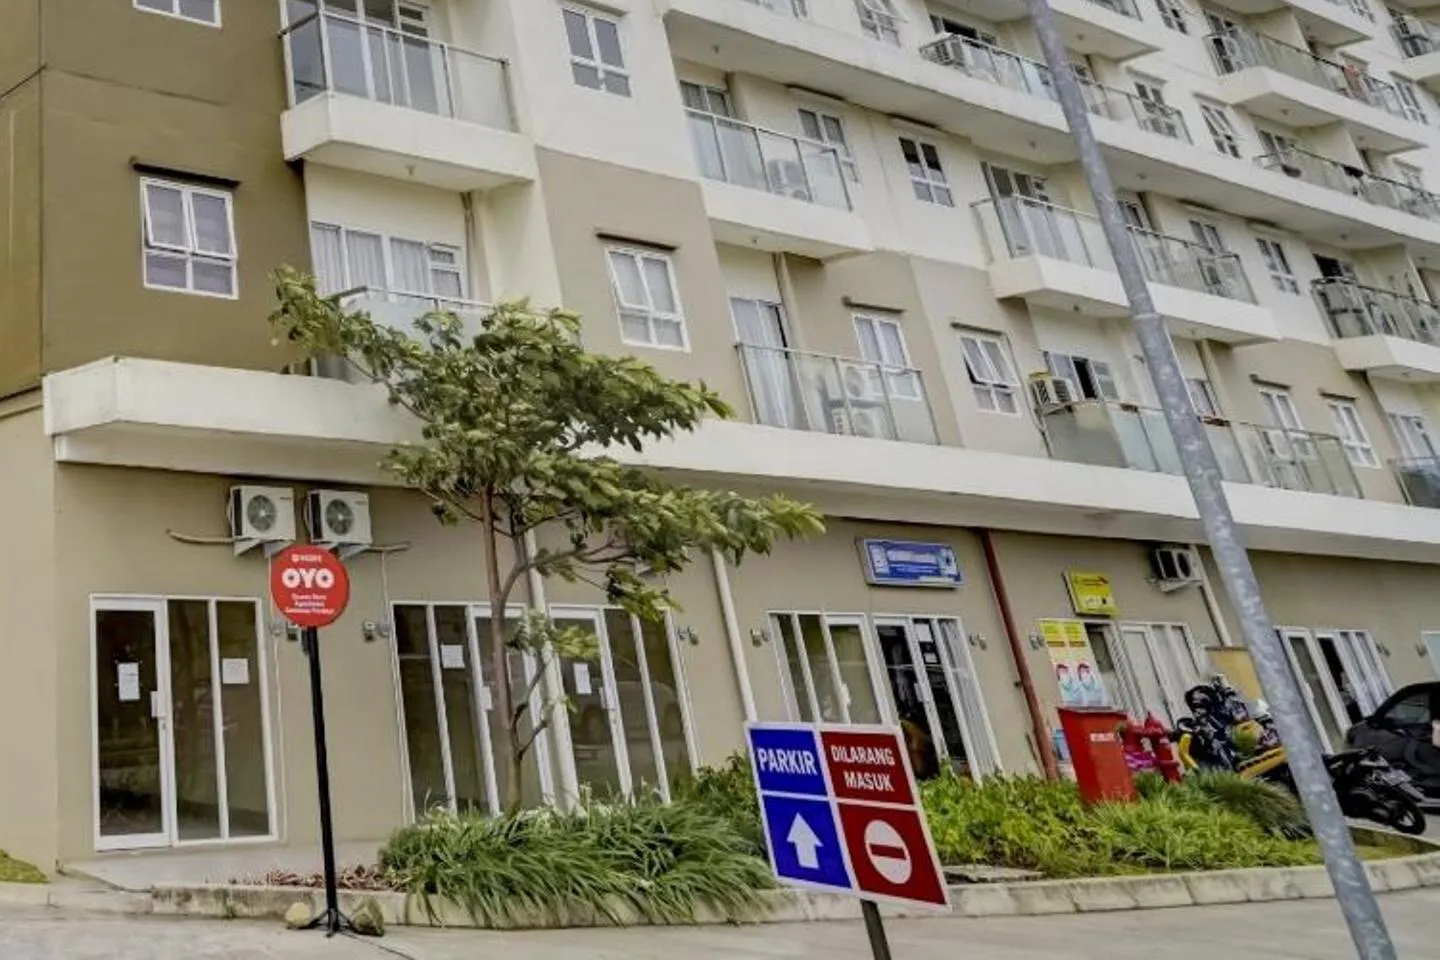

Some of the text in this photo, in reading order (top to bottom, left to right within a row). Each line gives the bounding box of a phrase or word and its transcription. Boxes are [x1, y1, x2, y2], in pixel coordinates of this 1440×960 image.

[281, 568, 335, 589] OYO
[757, 748, 818, 776] PARKIR
[830, 744, 896, 766] DILARANG
[843, 771, 894, 792] MASUK
